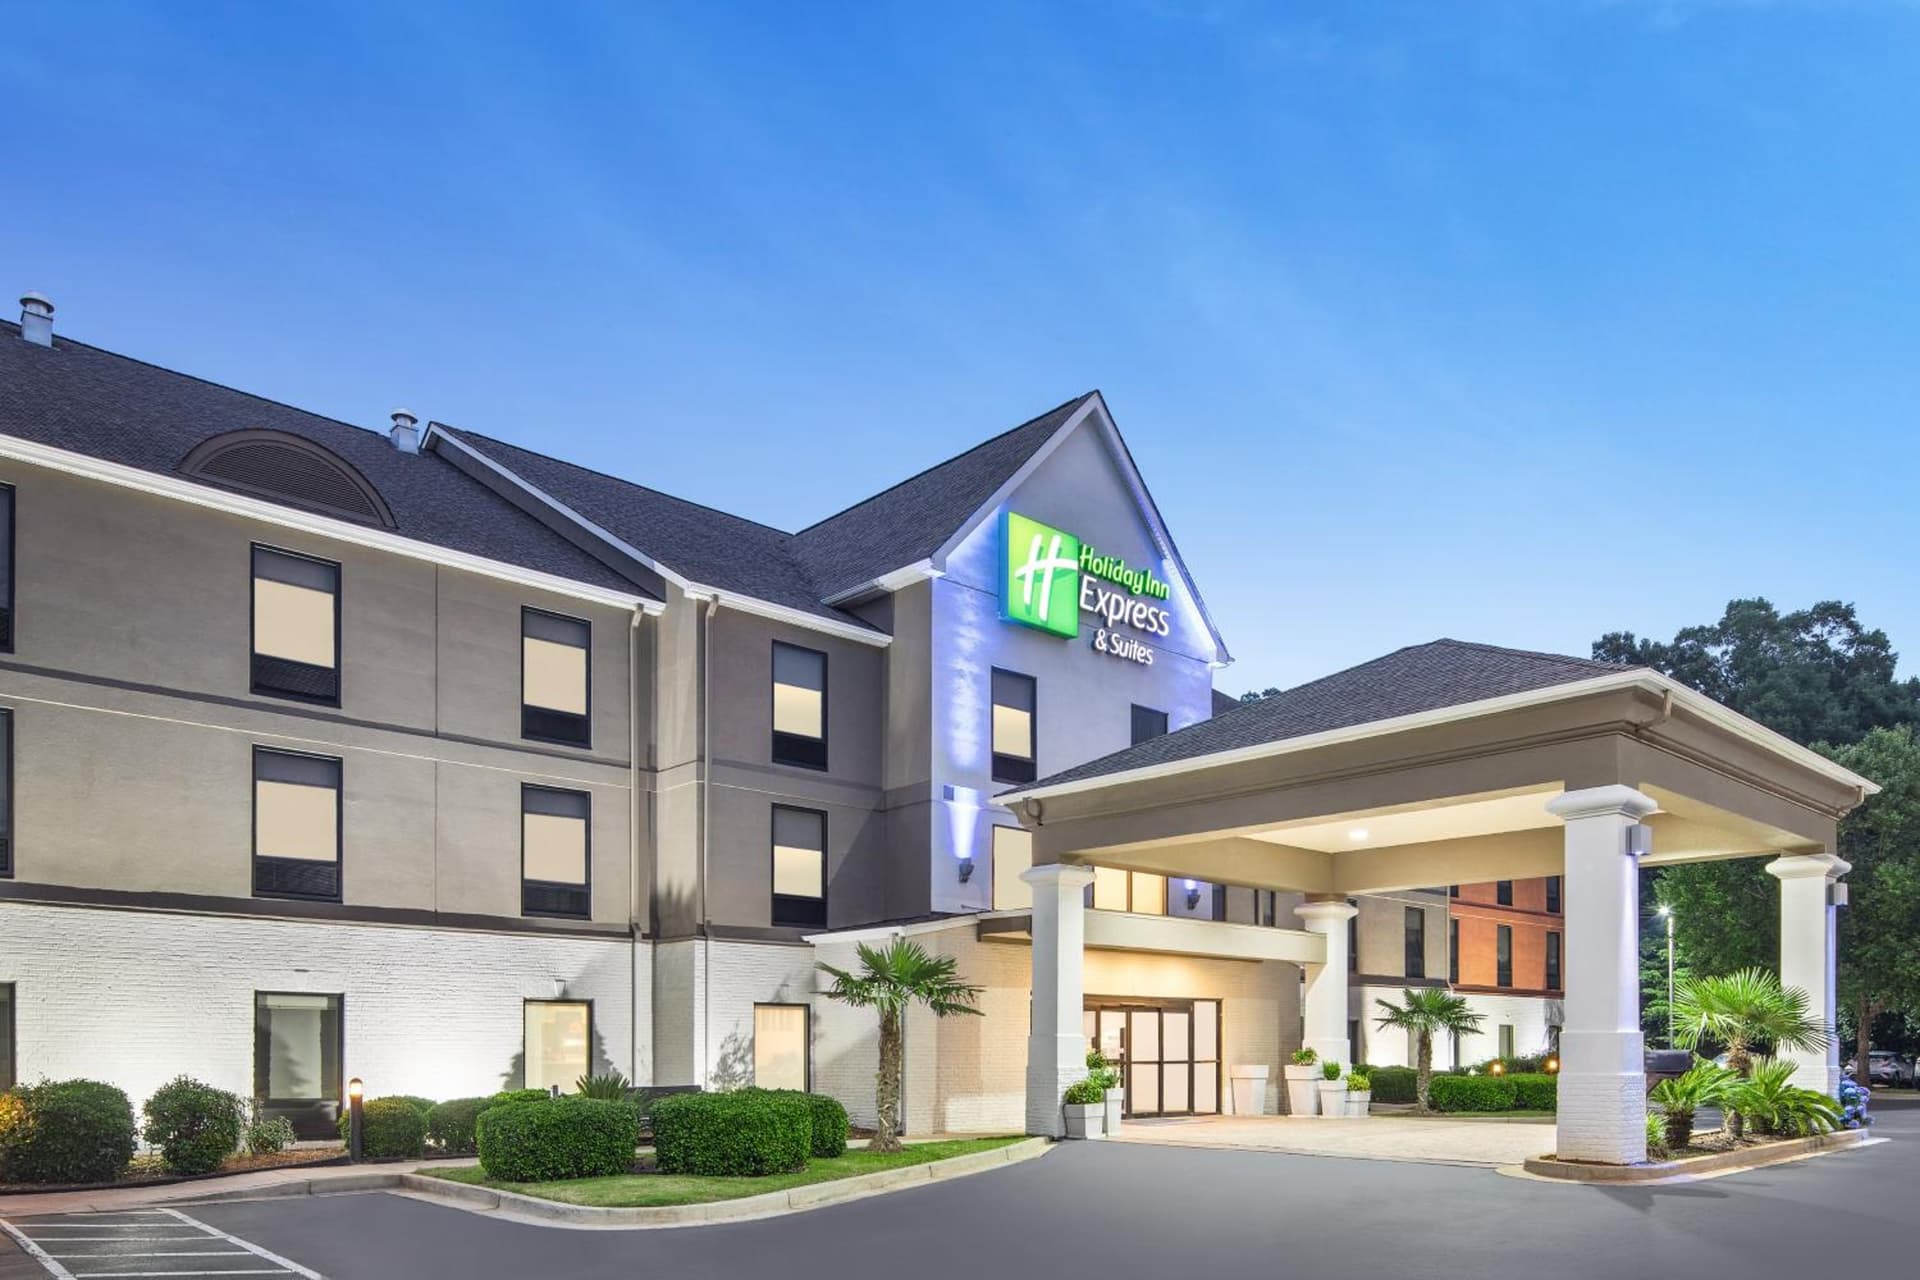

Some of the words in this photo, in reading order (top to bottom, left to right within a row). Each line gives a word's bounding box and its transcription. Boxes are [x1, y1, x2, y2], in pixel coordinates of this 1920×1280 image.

[1079, 544, 1144, 594] Holiday
[1146, 570, 1170, 599] Inn
[1079, 575, 1170, 636] Express
[1095, 629, 1107, 651] &
[1110, 633, 1153, 665] Suites
